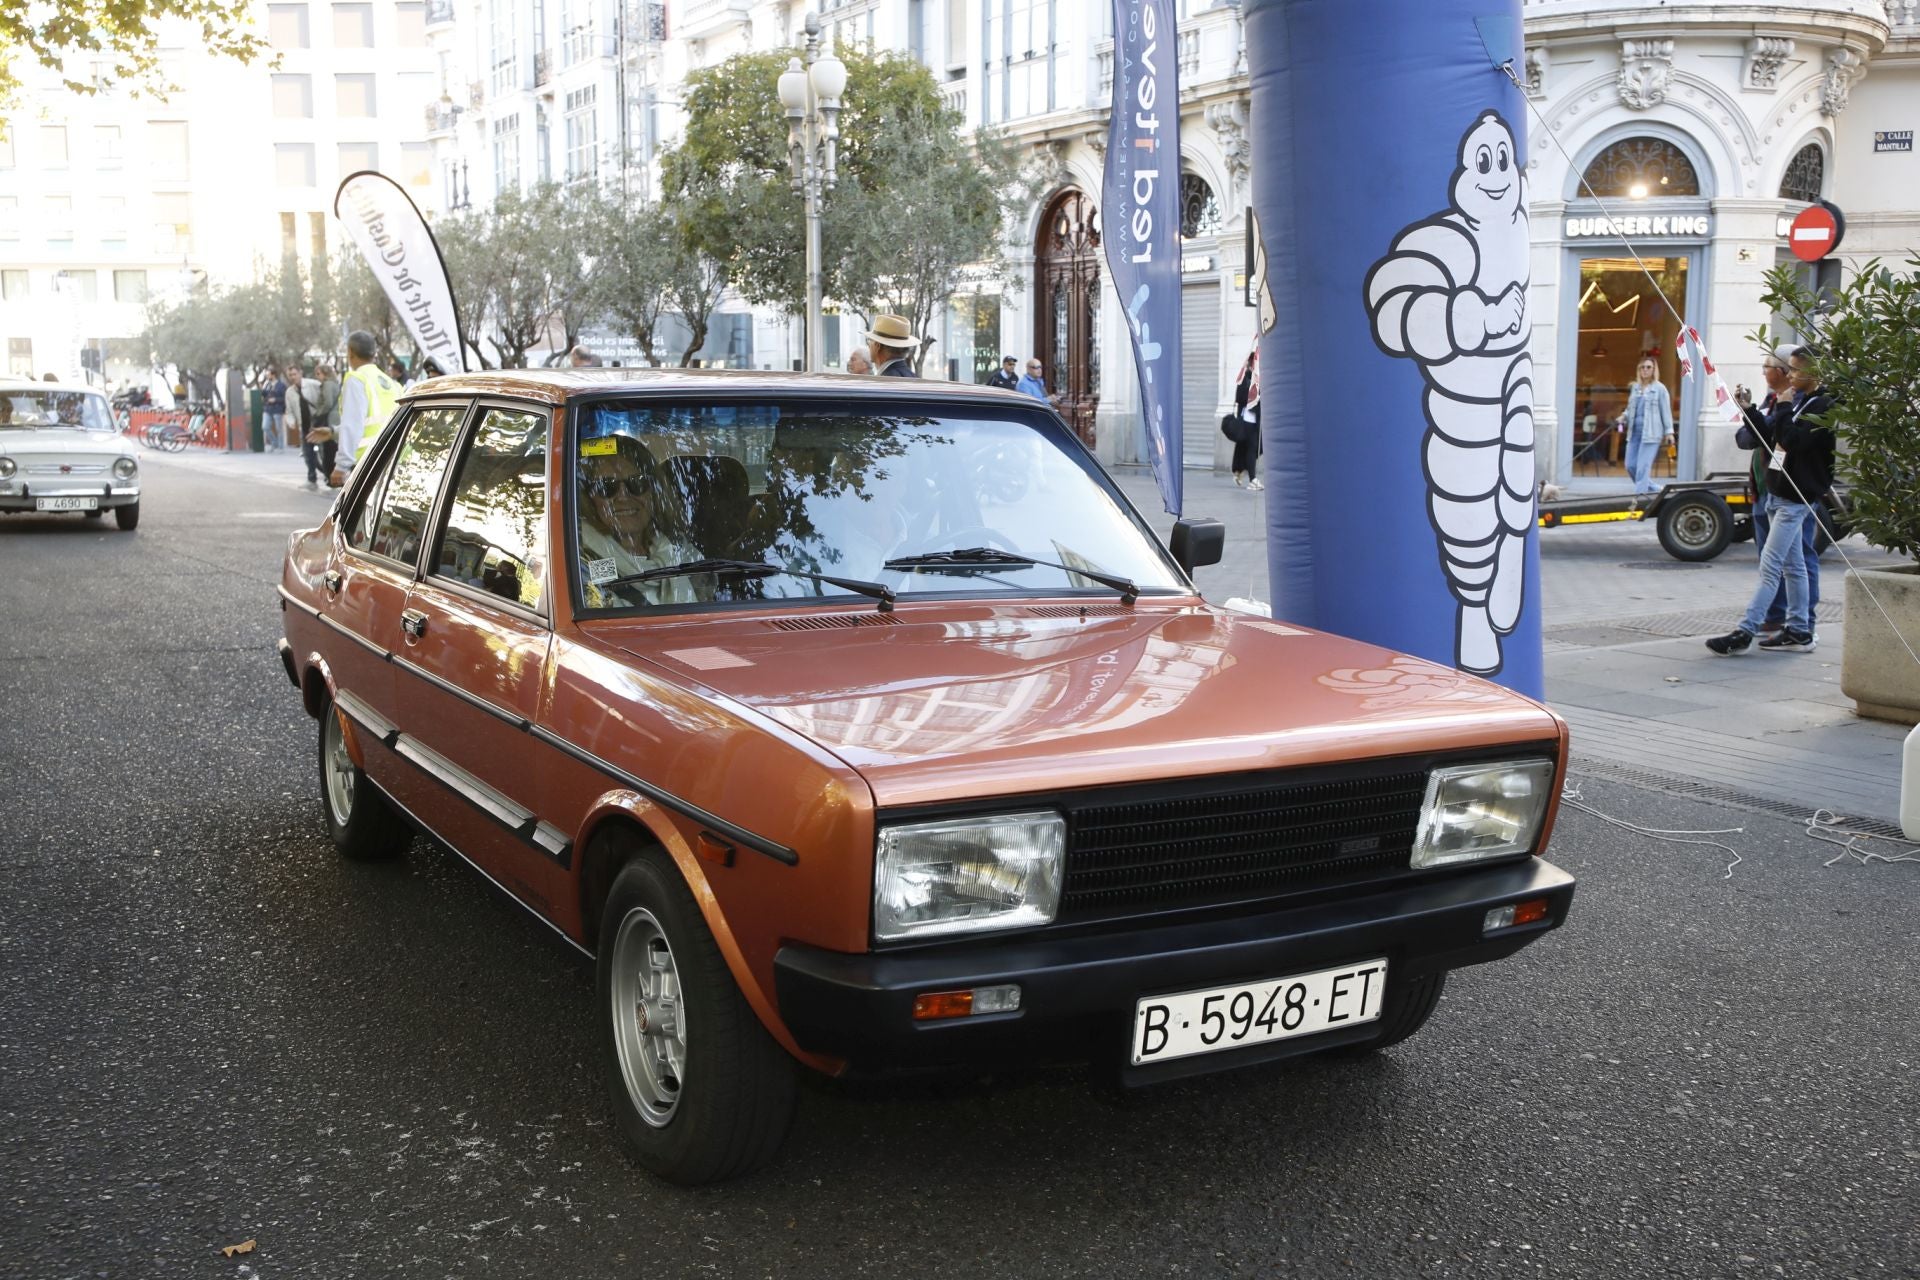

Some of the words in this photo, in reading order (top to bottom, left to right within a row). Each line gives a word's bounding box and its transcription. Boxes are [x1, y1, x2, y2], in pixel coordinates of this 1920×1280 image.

[1887, 131, 1912, 140] CALLE
[1877, 142, 1910, 151] MANTILLA
[1566, 217, 1650, 237] BURGER
[578, 335, 603, 345] Todo
[605, 337, 616, 345] es
[54, 499, 81, 509] 4690
